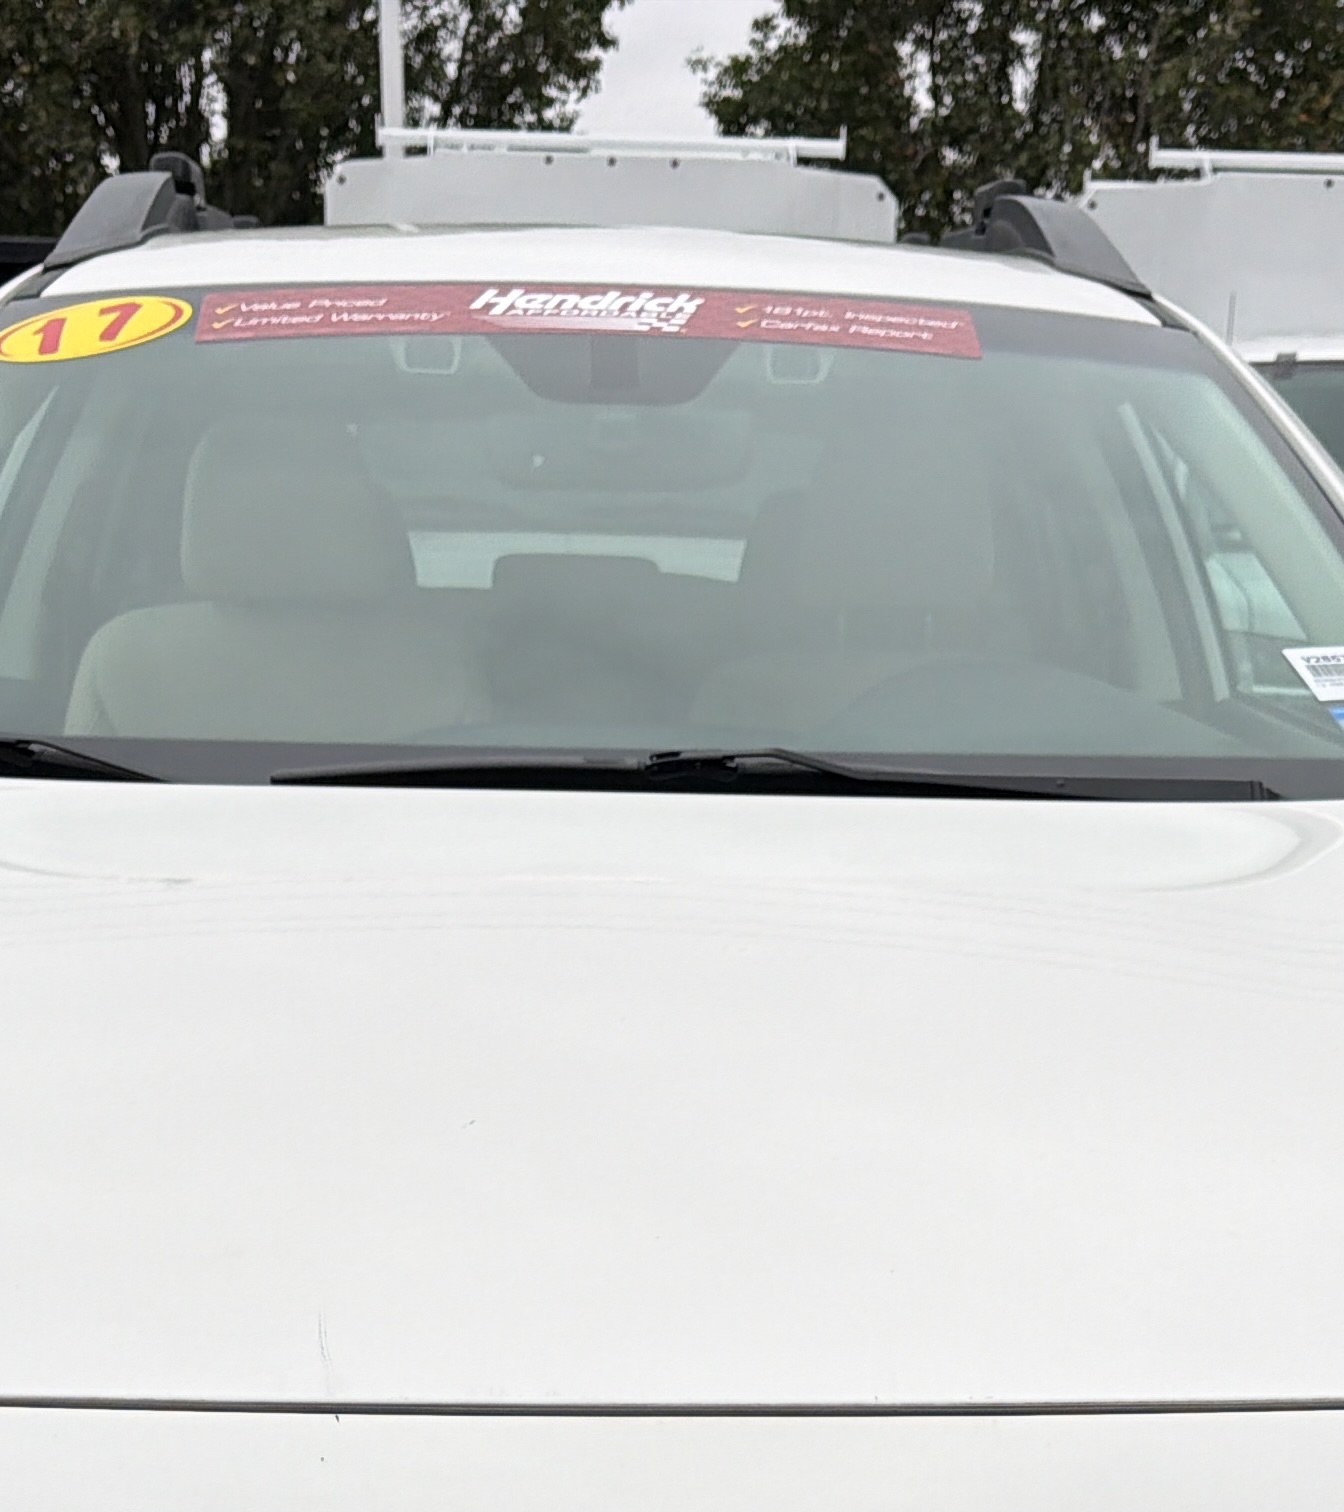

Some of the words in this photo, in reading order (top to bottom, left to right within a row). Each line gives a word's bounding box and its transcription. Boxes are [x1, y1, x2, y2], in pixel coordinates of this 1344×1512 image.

[239, 302, 302, 313] Value
[308, 298, 388, 309] Priced
[469, 288, 706, 316] Hendrick
[33, 302, 143, 356] 17
